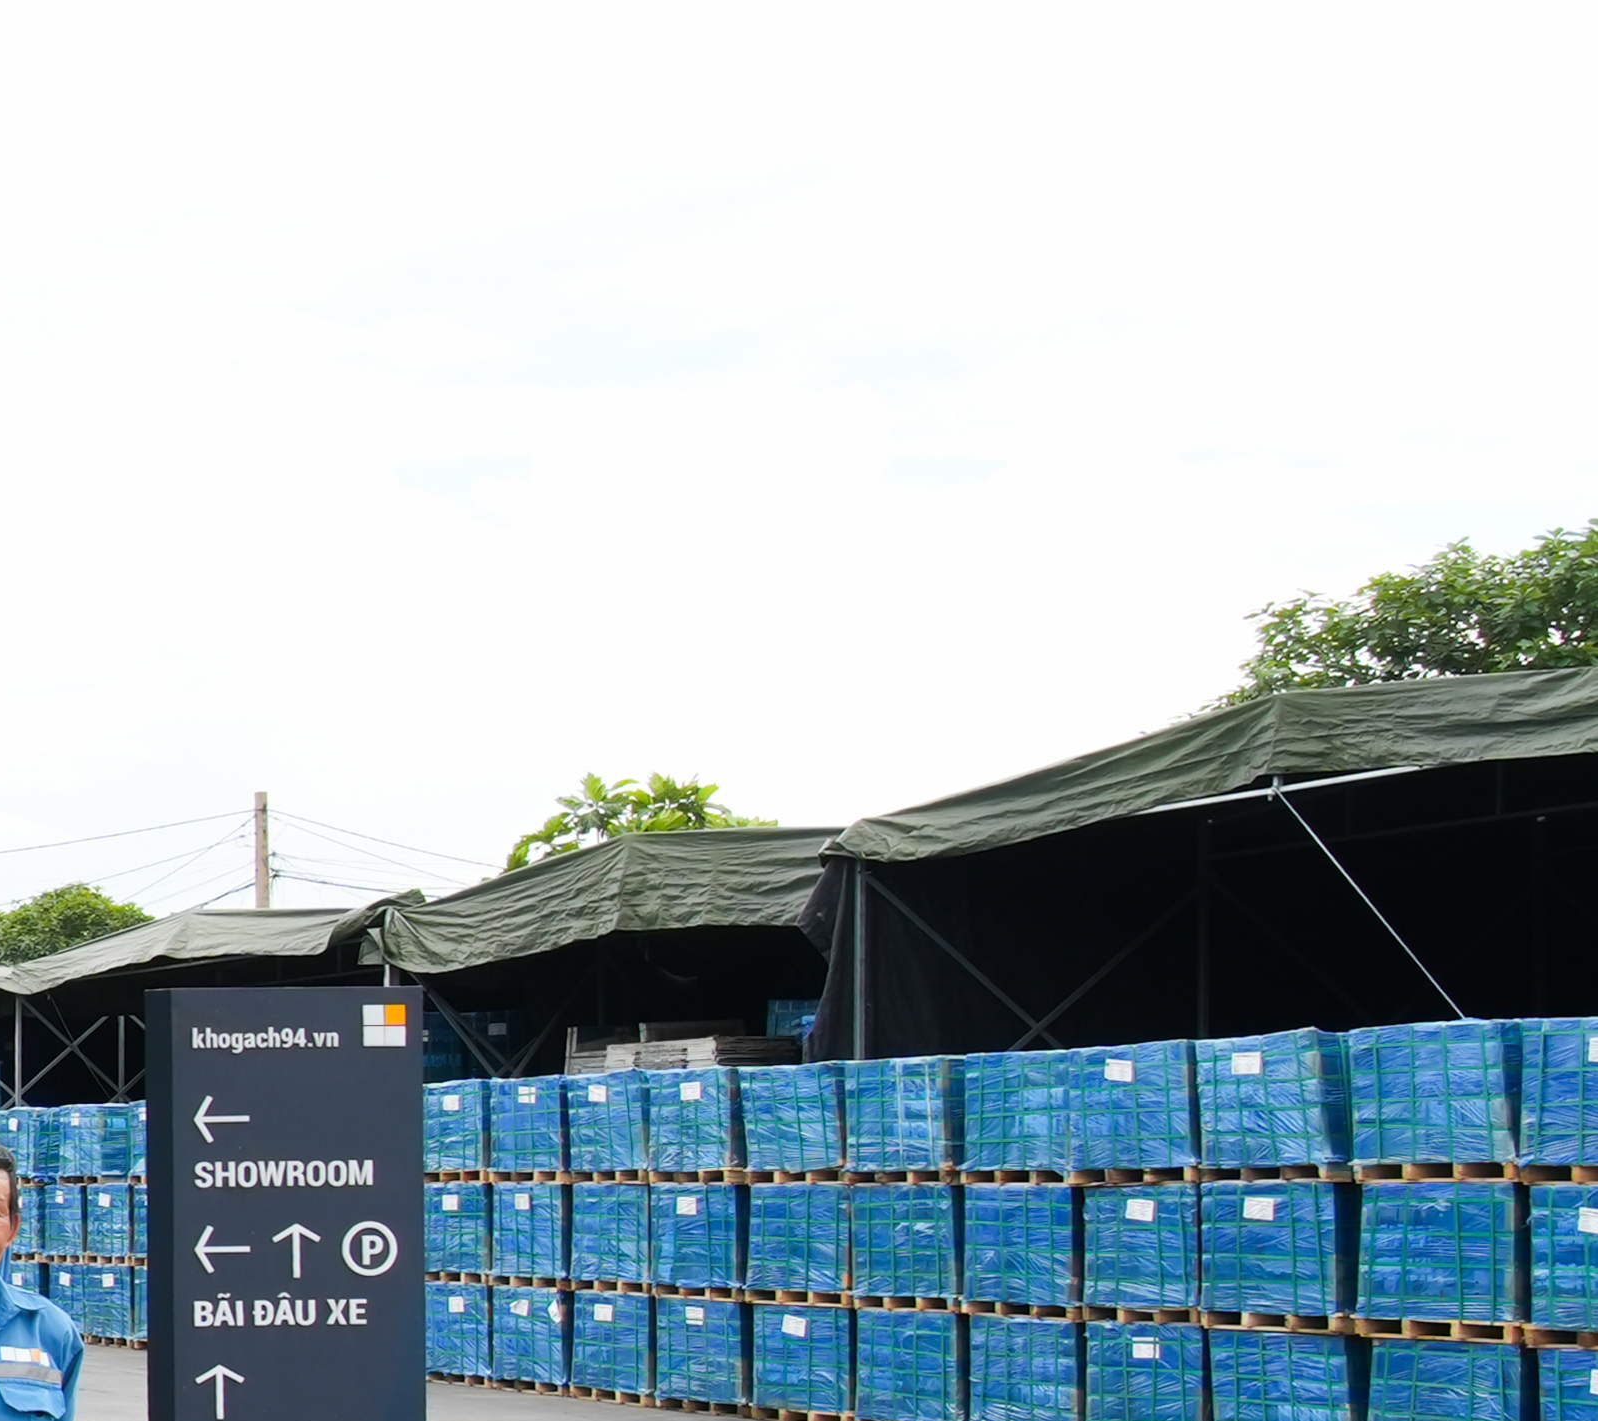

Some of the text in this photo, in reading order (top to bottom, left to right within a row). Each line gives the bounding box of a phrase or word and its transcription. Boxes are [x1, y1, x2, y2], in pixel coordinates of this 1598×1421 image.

[191, 1026, 340, 1055] khogach94.vn
[193, 1159, 375, 1189] SHOWROOM
[192, 1291, 369, 1328] BÃI ĐÂU XE
